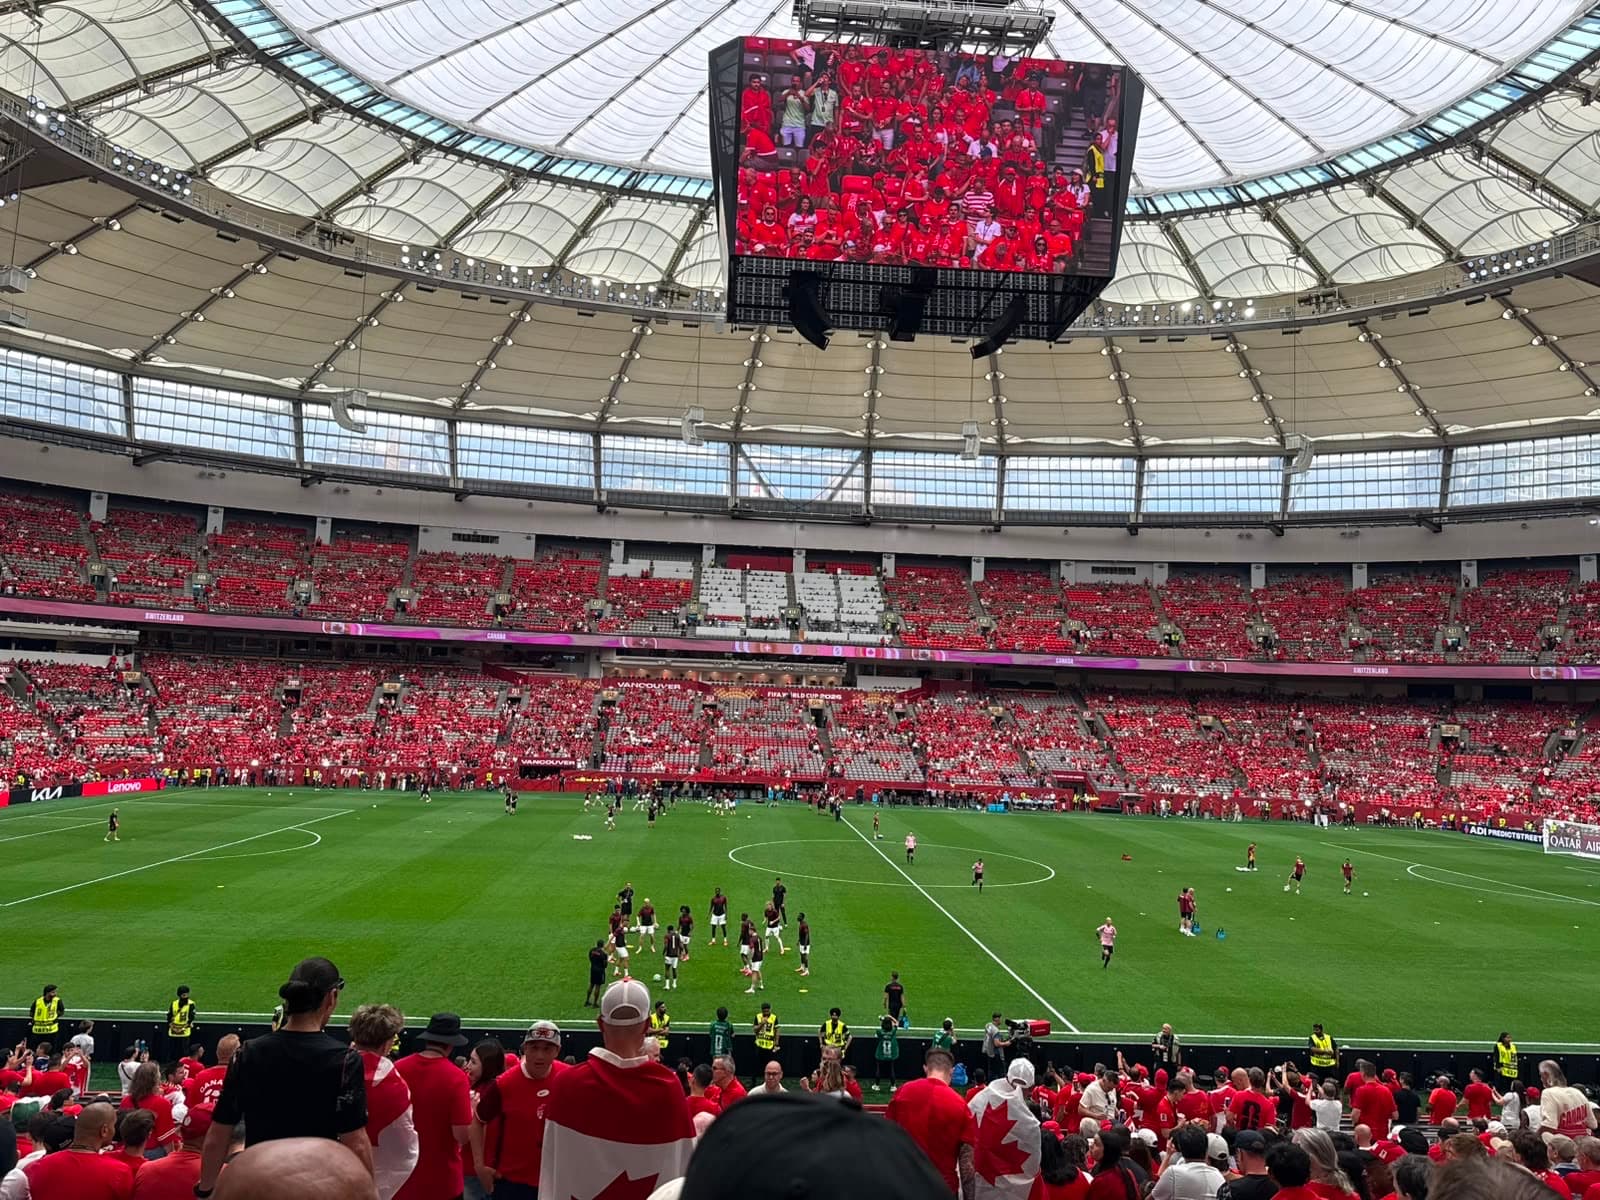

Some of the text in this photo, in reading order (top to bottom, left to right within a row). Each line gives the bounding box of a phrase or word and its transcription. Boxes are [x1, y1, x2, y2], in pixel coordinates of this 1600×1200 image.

[144, 612, 184, 622] SWITZERLAND
[487, 632, 507, 640] CANADA
[617, 682, 681, 690] VANCOUVER
[108, 781, 142, 793] Lenovo
[31, 786, 63, 802] KIA
[1470, 825, 1543, 843] ADI PREDICTSTREET
[1550, 835, 1581, 849] QATAR
